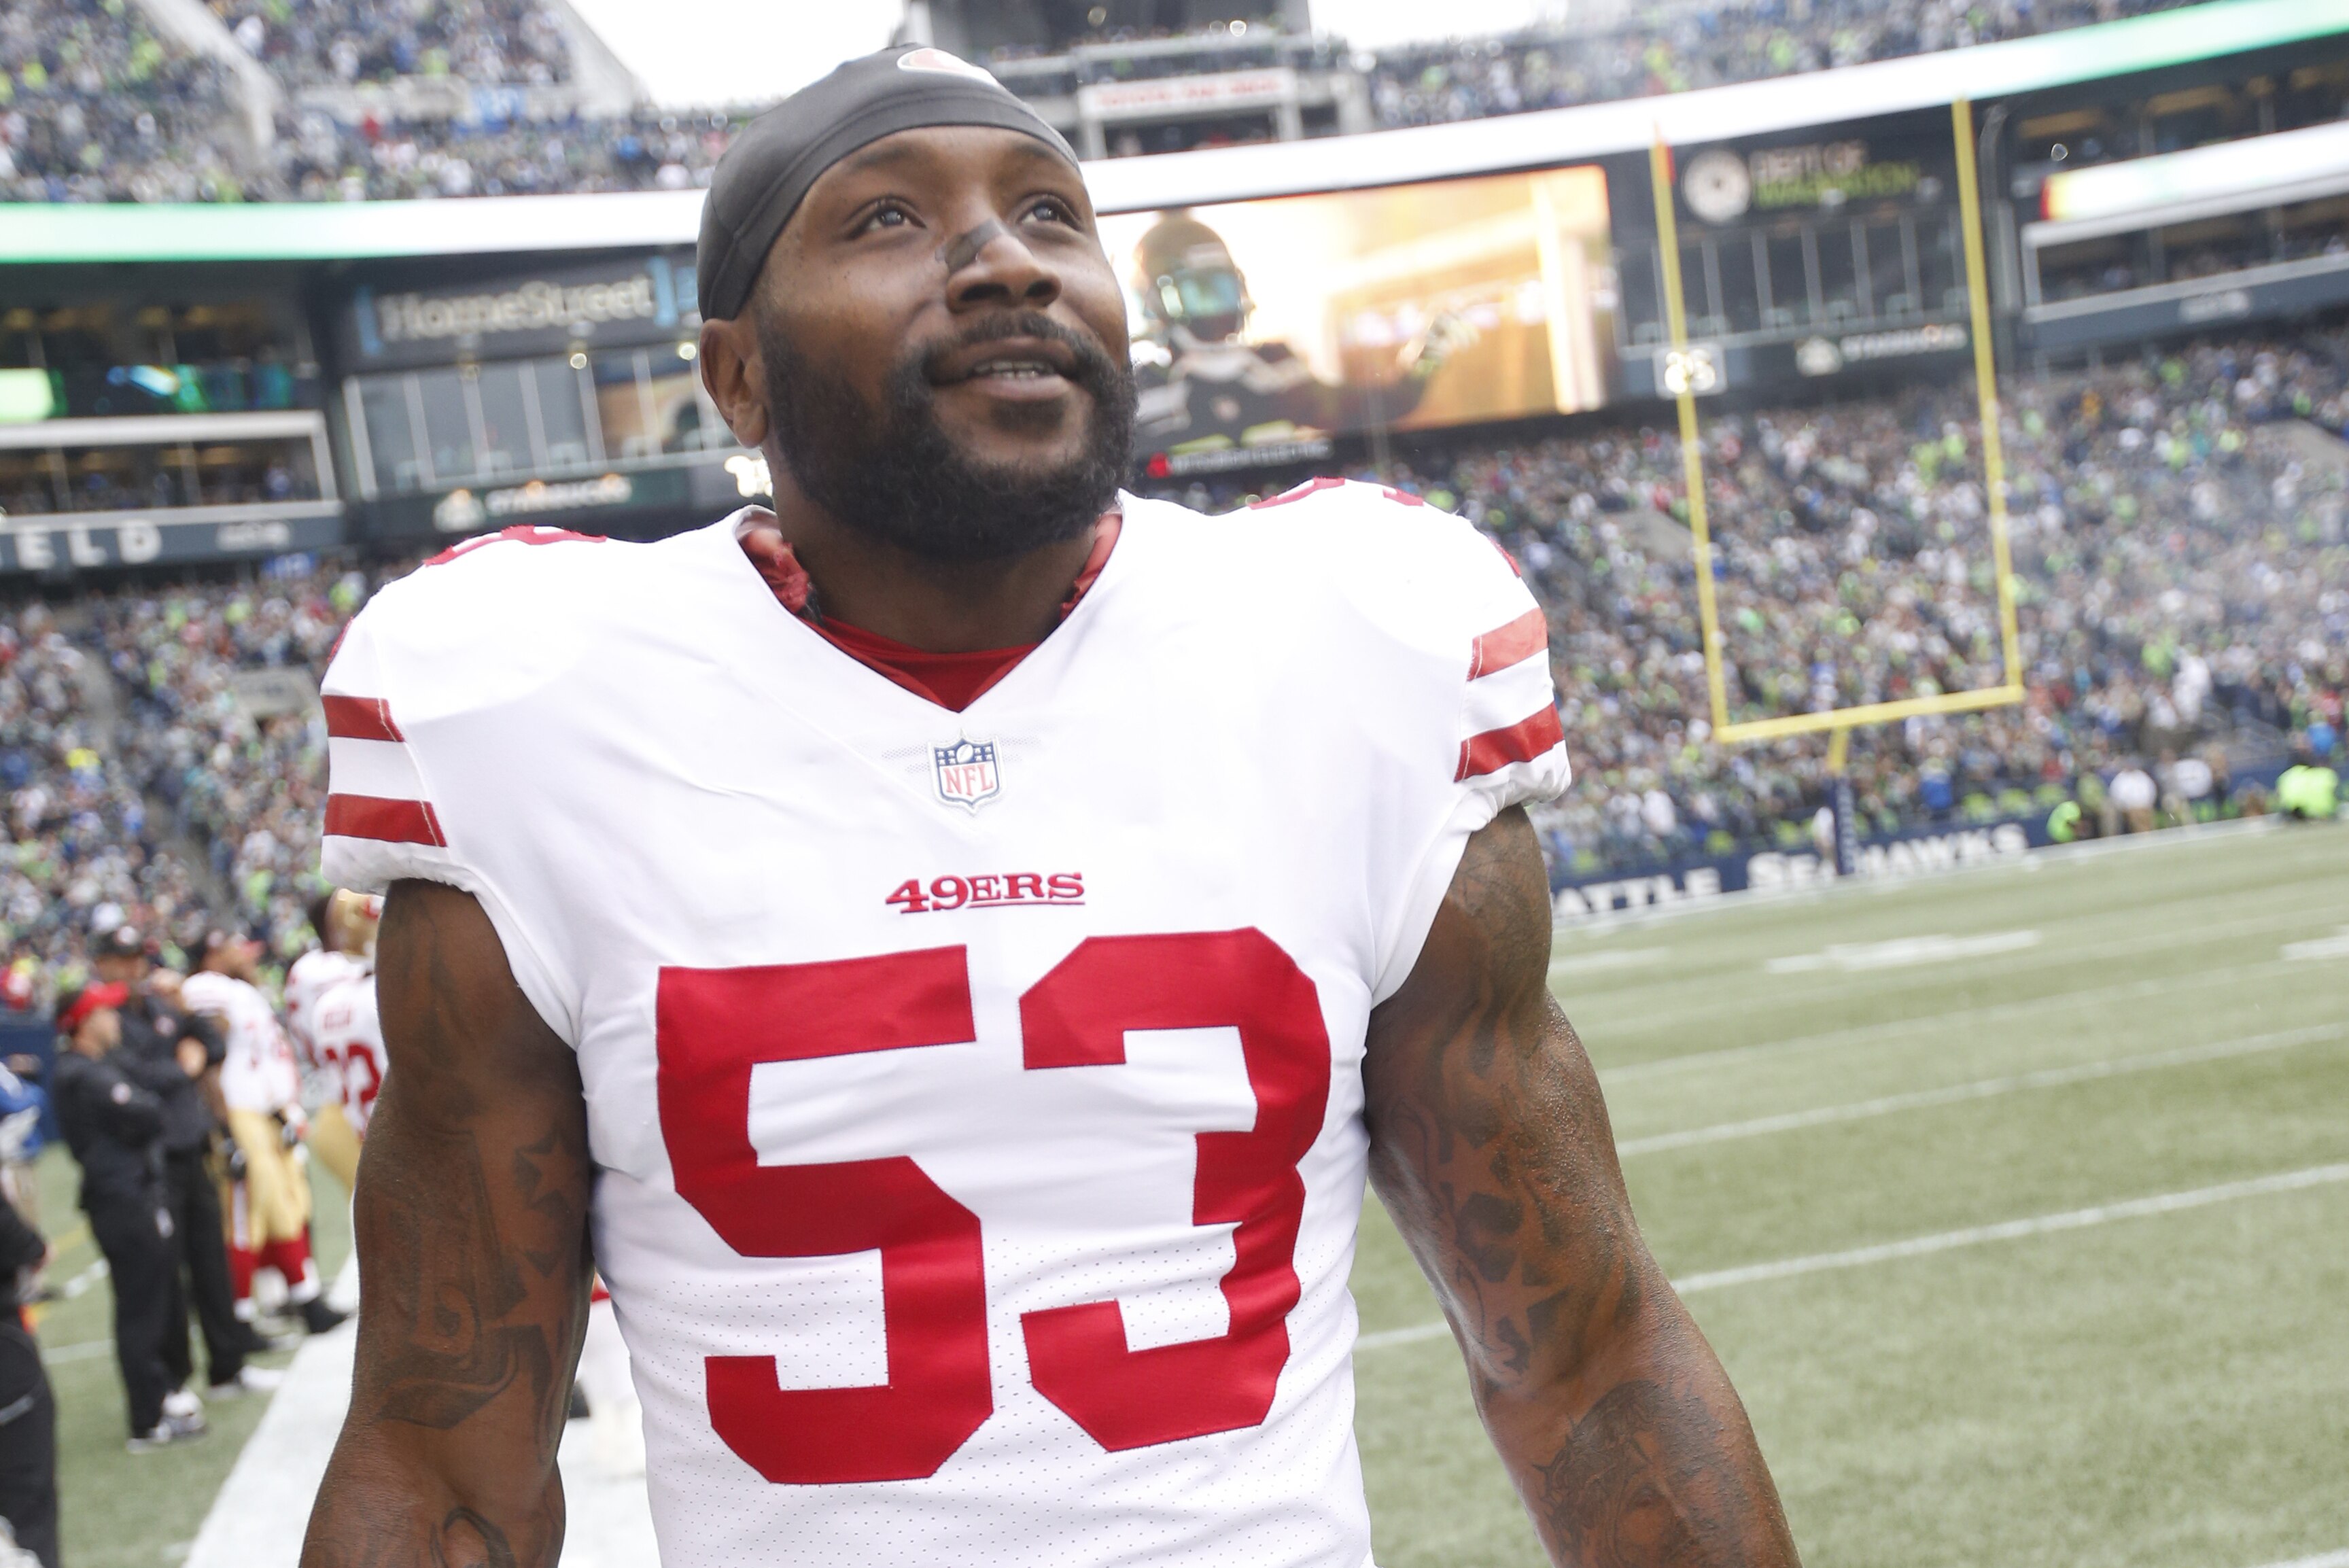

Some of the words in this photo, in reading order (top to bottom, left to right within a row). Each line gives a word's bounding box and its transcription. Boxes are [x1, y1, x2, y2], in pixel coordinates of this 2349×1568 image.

[0, 519, 162, 570] ELD
[943, 763, 994, 797] NFL
[885, 871, 1086, 914] 49ERS
[1550, 866, 1722, 916] ATTLE
[656, 926, 1331, 1485] 53
